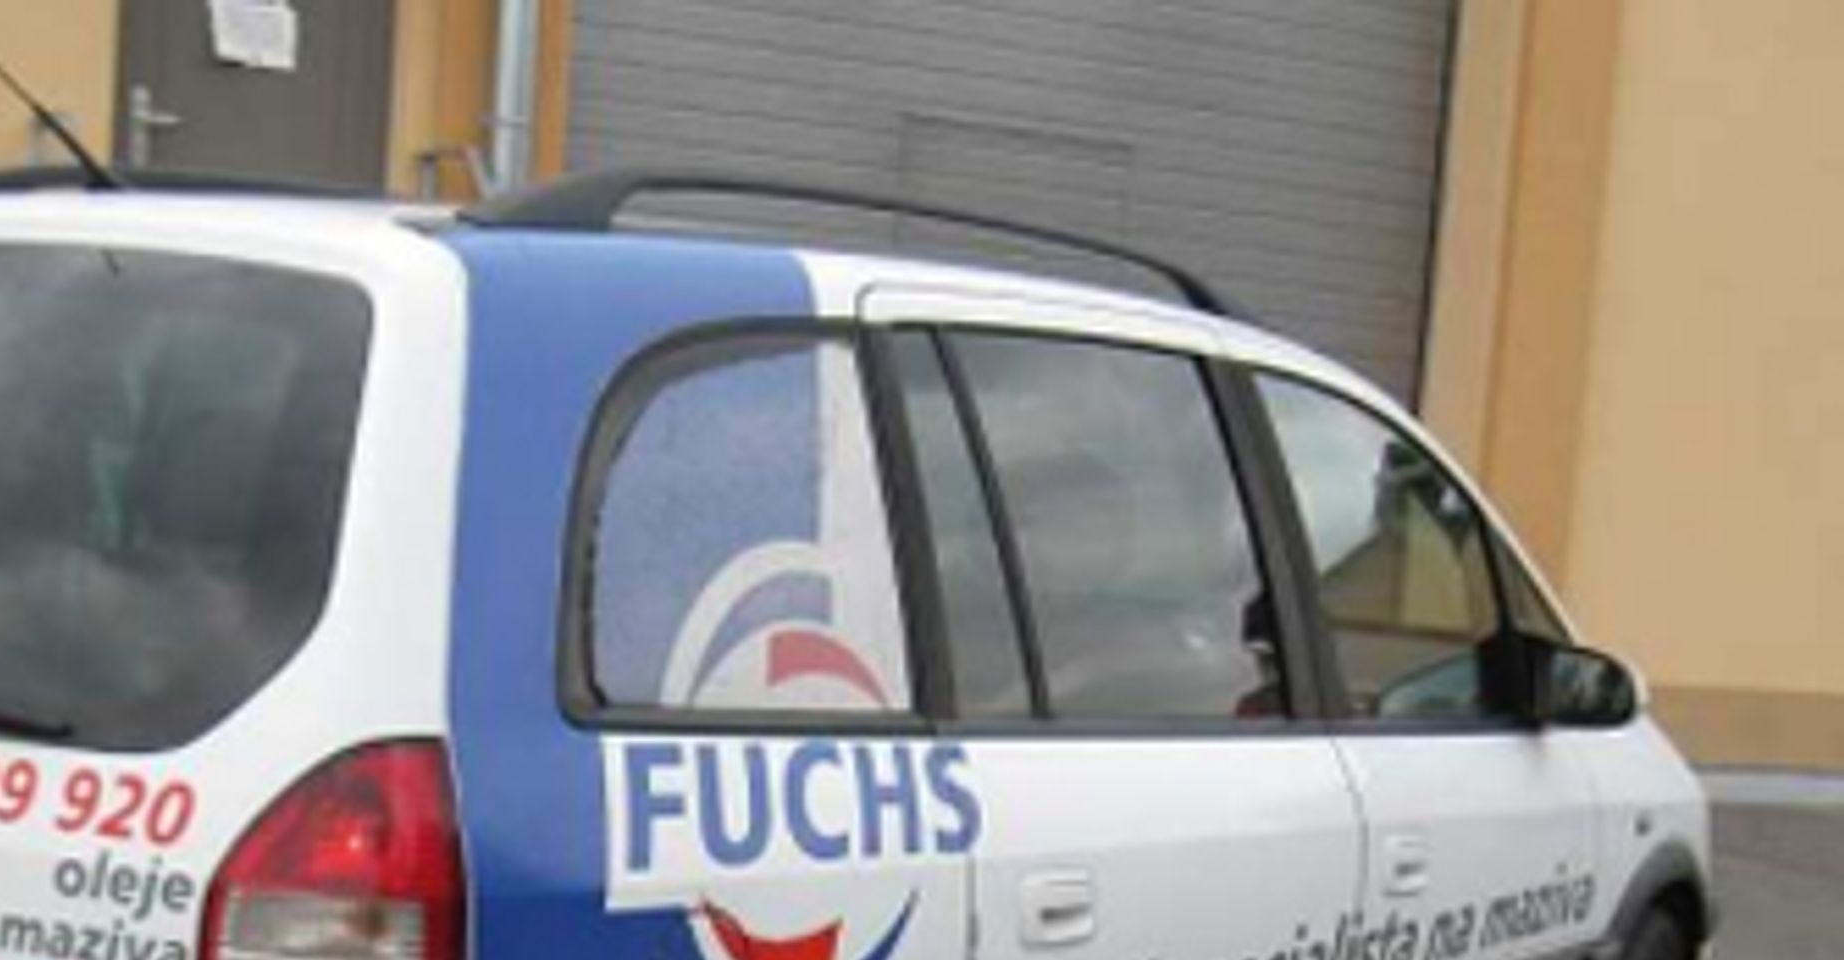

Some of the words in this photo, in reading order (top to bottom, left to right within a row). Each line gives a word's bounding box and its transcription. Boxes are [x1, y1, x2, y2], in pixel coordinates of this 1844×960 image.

[54, 767, 196, 848] 920
[623, 740, 983, 874] FUCHS
[54, 848, 195, 922] oleje
[1478, 863, 1597, 948] maziva
